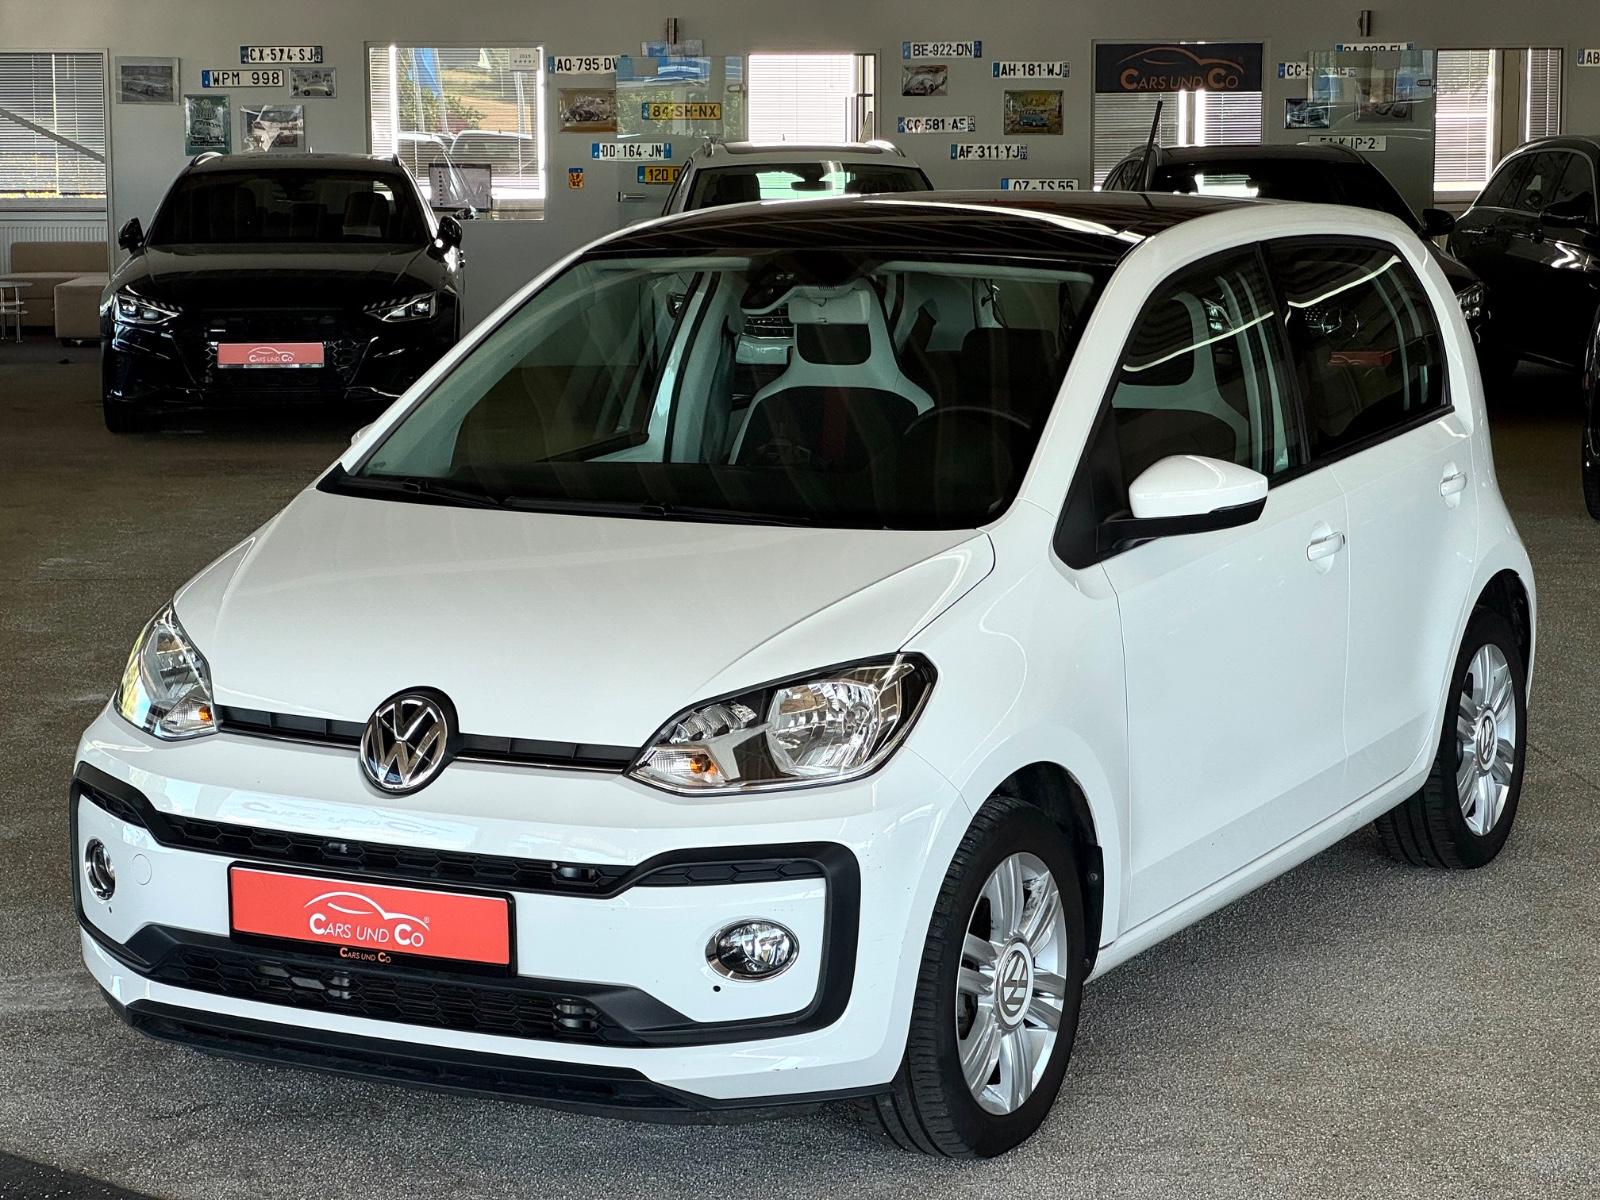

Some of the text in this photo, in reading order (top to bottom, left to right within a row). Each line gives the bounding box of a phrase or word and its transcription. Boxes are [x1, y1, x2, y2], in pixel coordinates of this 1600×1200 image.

[212, 71, 280, 86] WPM 998
[648, 168, 669, 182] 120
[309, 912, 425, 948] CARS UND CO
